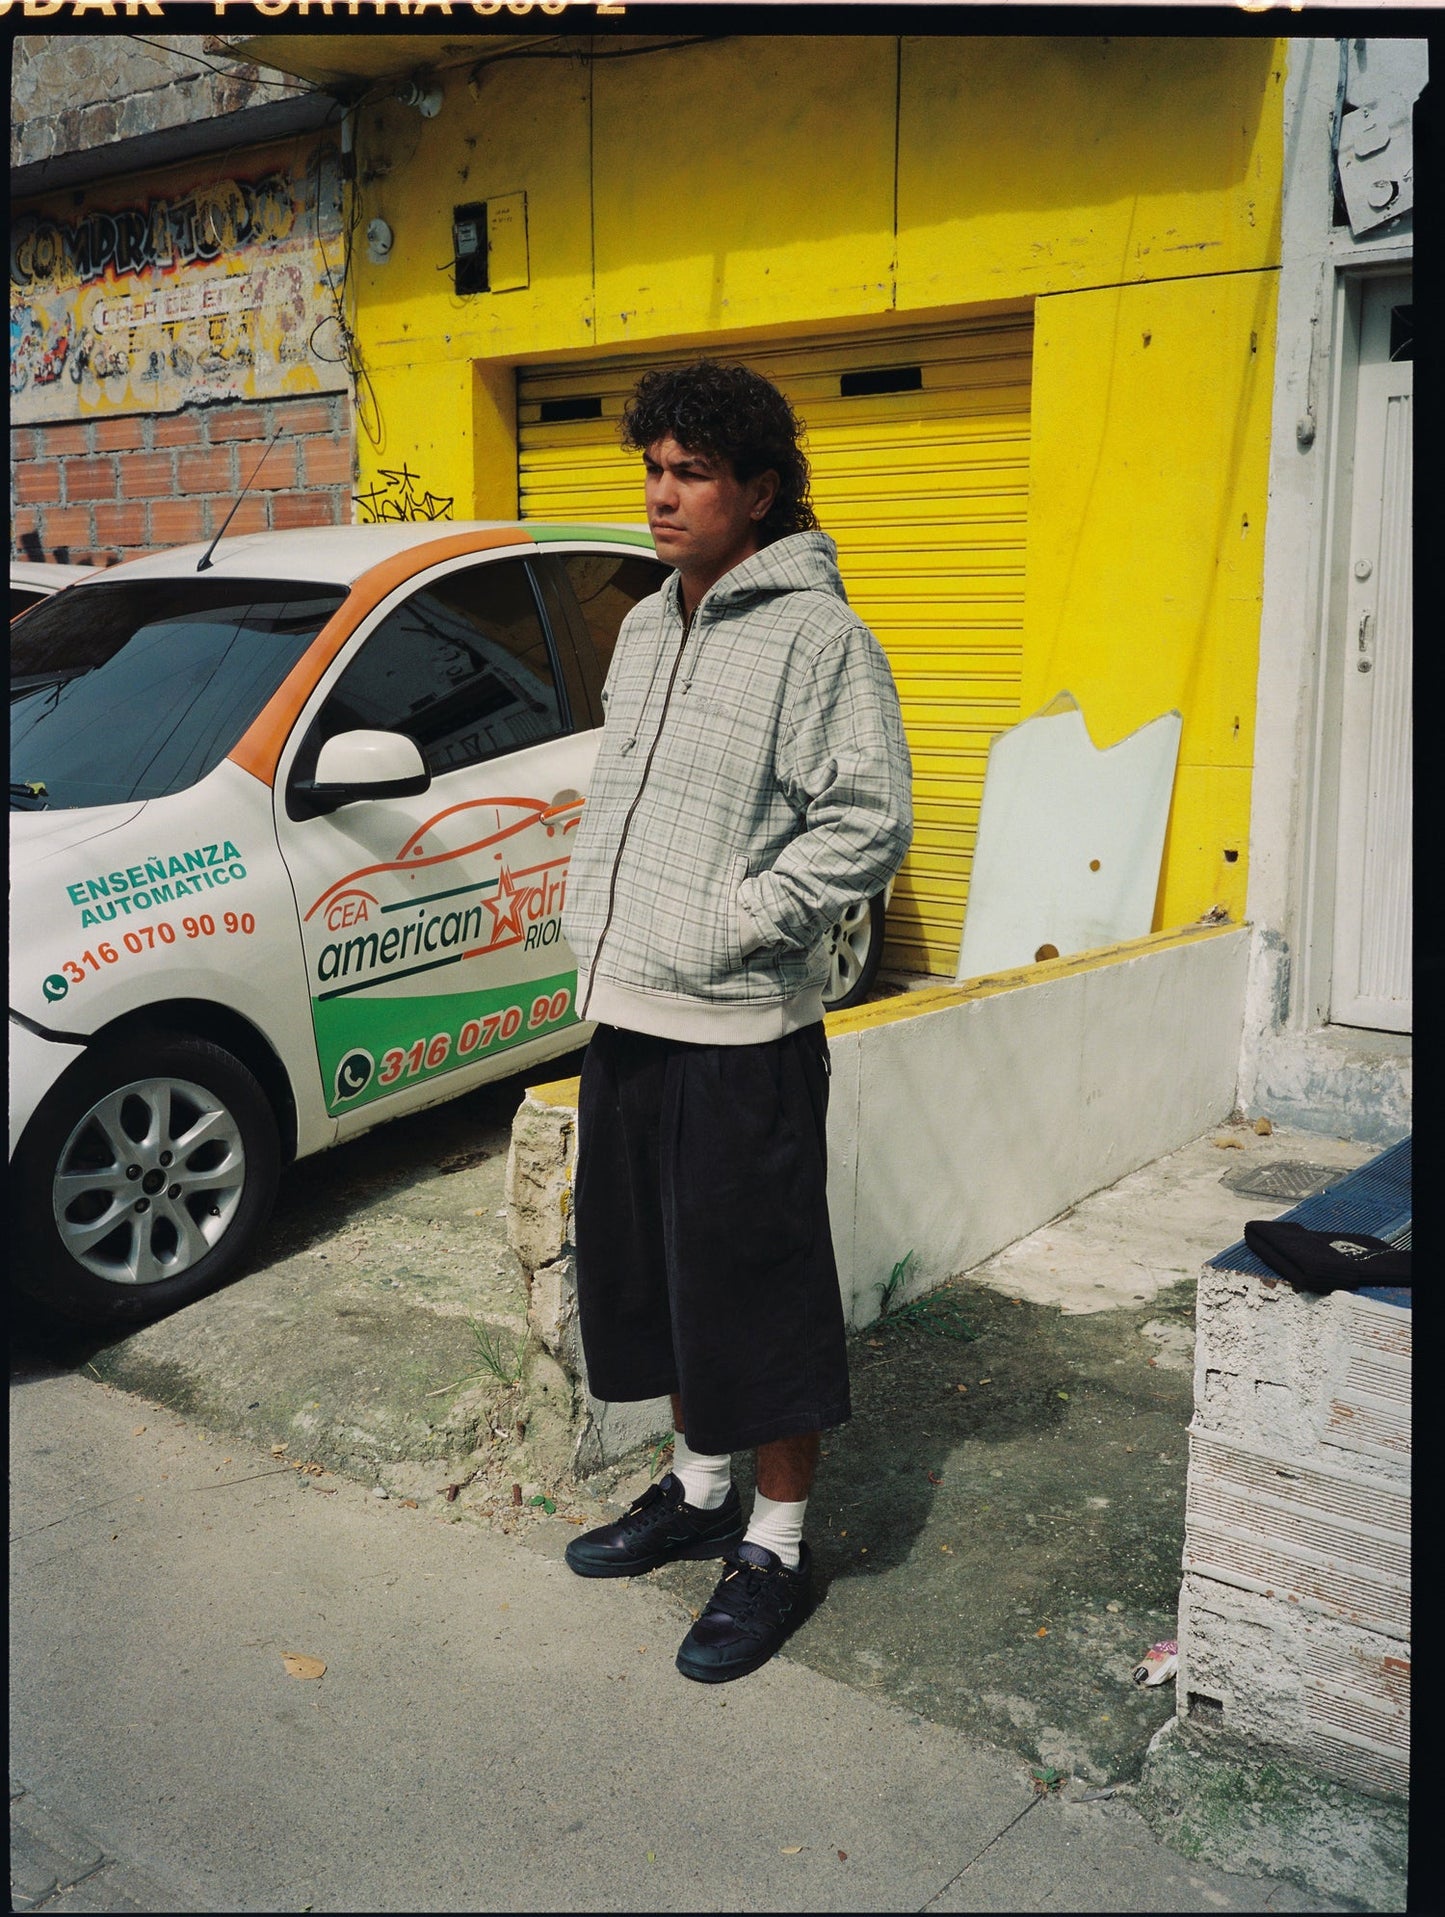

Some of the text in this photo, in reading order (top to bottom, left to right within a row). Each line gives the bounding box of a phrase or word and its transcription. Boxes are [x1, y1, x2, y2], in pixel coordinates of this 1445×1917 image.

[66, 840, 241, 906] ENSEÑANZA
[82, 863, 247, 928] AUTOMATICO
[62, 912, 255, 983] 316 070 90 90
[318, 906, 481, 981] american
[328, 899, 369, 931] CEA
[379, 989, 570, 1084] 316 070 90
